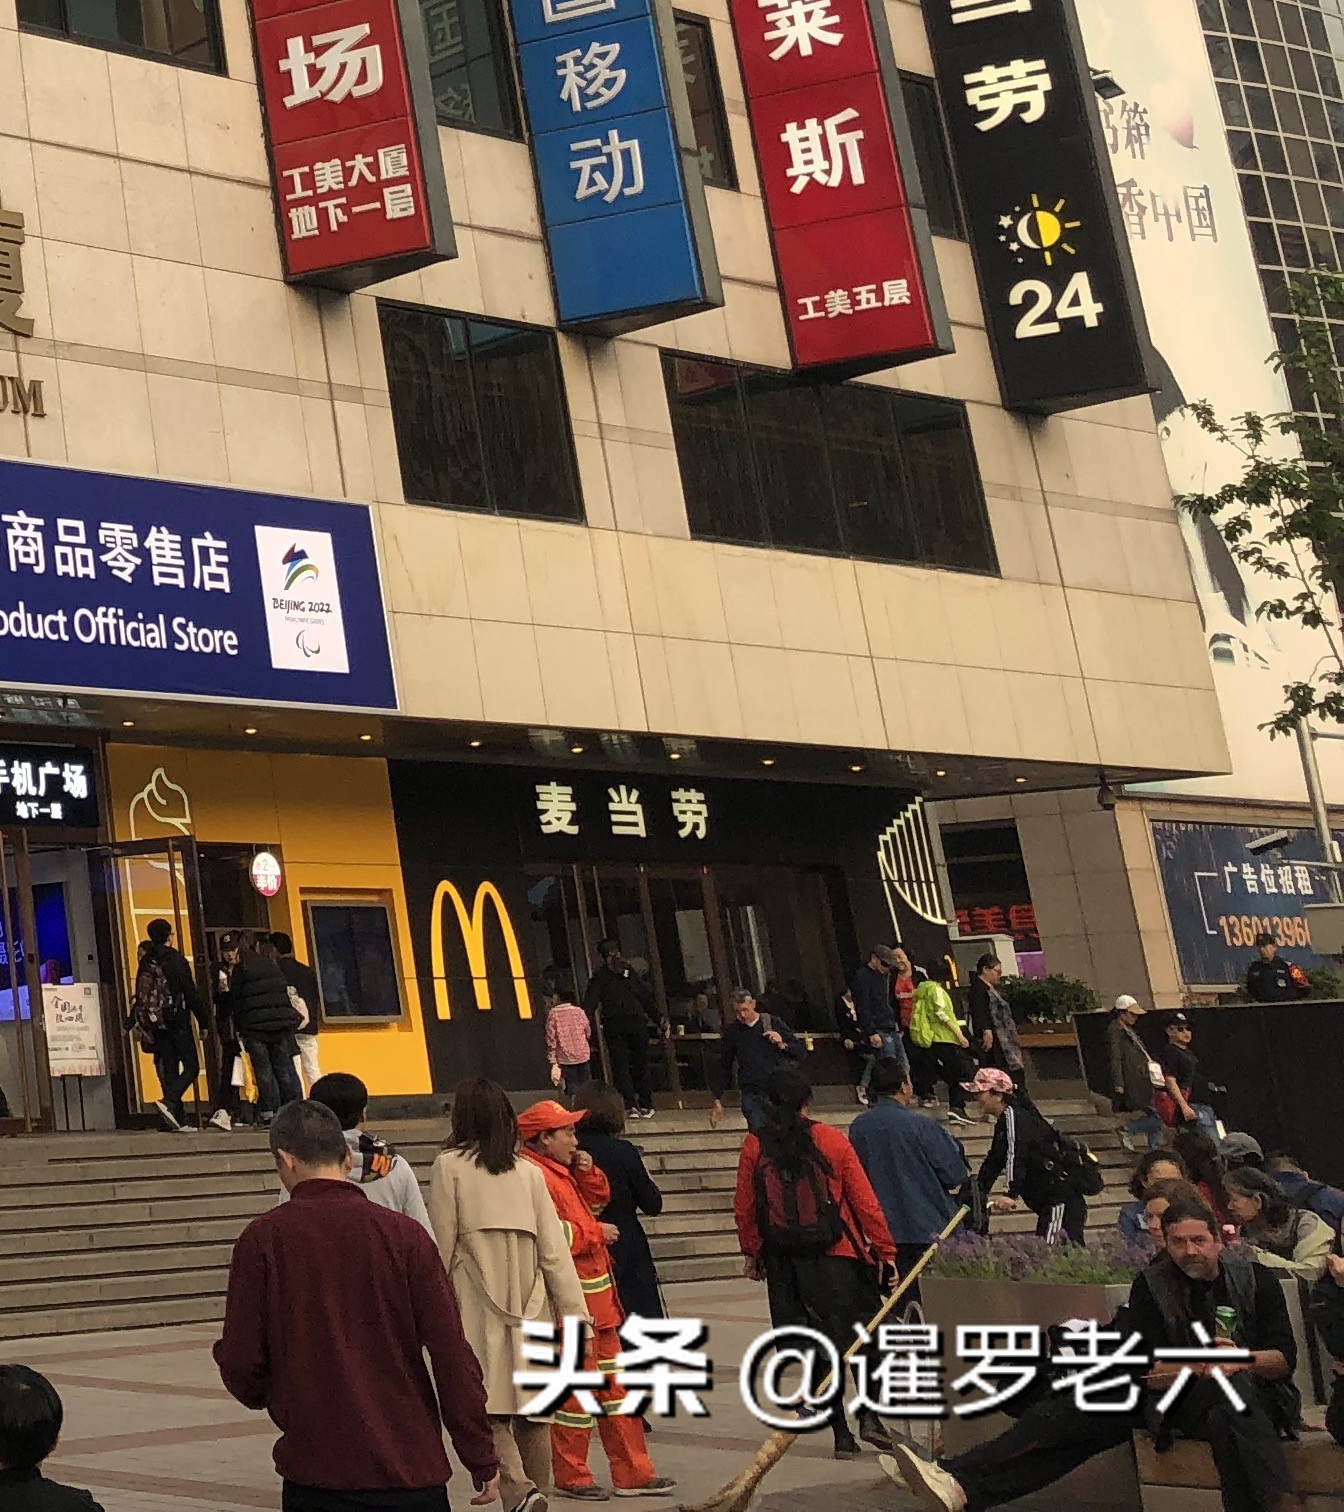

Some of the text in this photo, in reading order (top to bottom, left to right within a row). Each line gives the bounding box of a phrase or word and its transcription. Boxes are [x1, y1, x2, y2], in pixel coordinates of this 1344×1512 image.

[282, 143, 410, 201] 工美大厦
[288, 183, 416, 241] 地下一层
[797, 279, 912, 321] 工美五层
[1009, 271, 1105, 339] 24
[73, 605, 168, 650] Official
[172, 616, 239, 656] Store
[272, 598, 334, 614] BEIJING 2022
[534, 780, 711, 840] 麦当劳
[1223, 861, 1314, 896] 广告位招租
